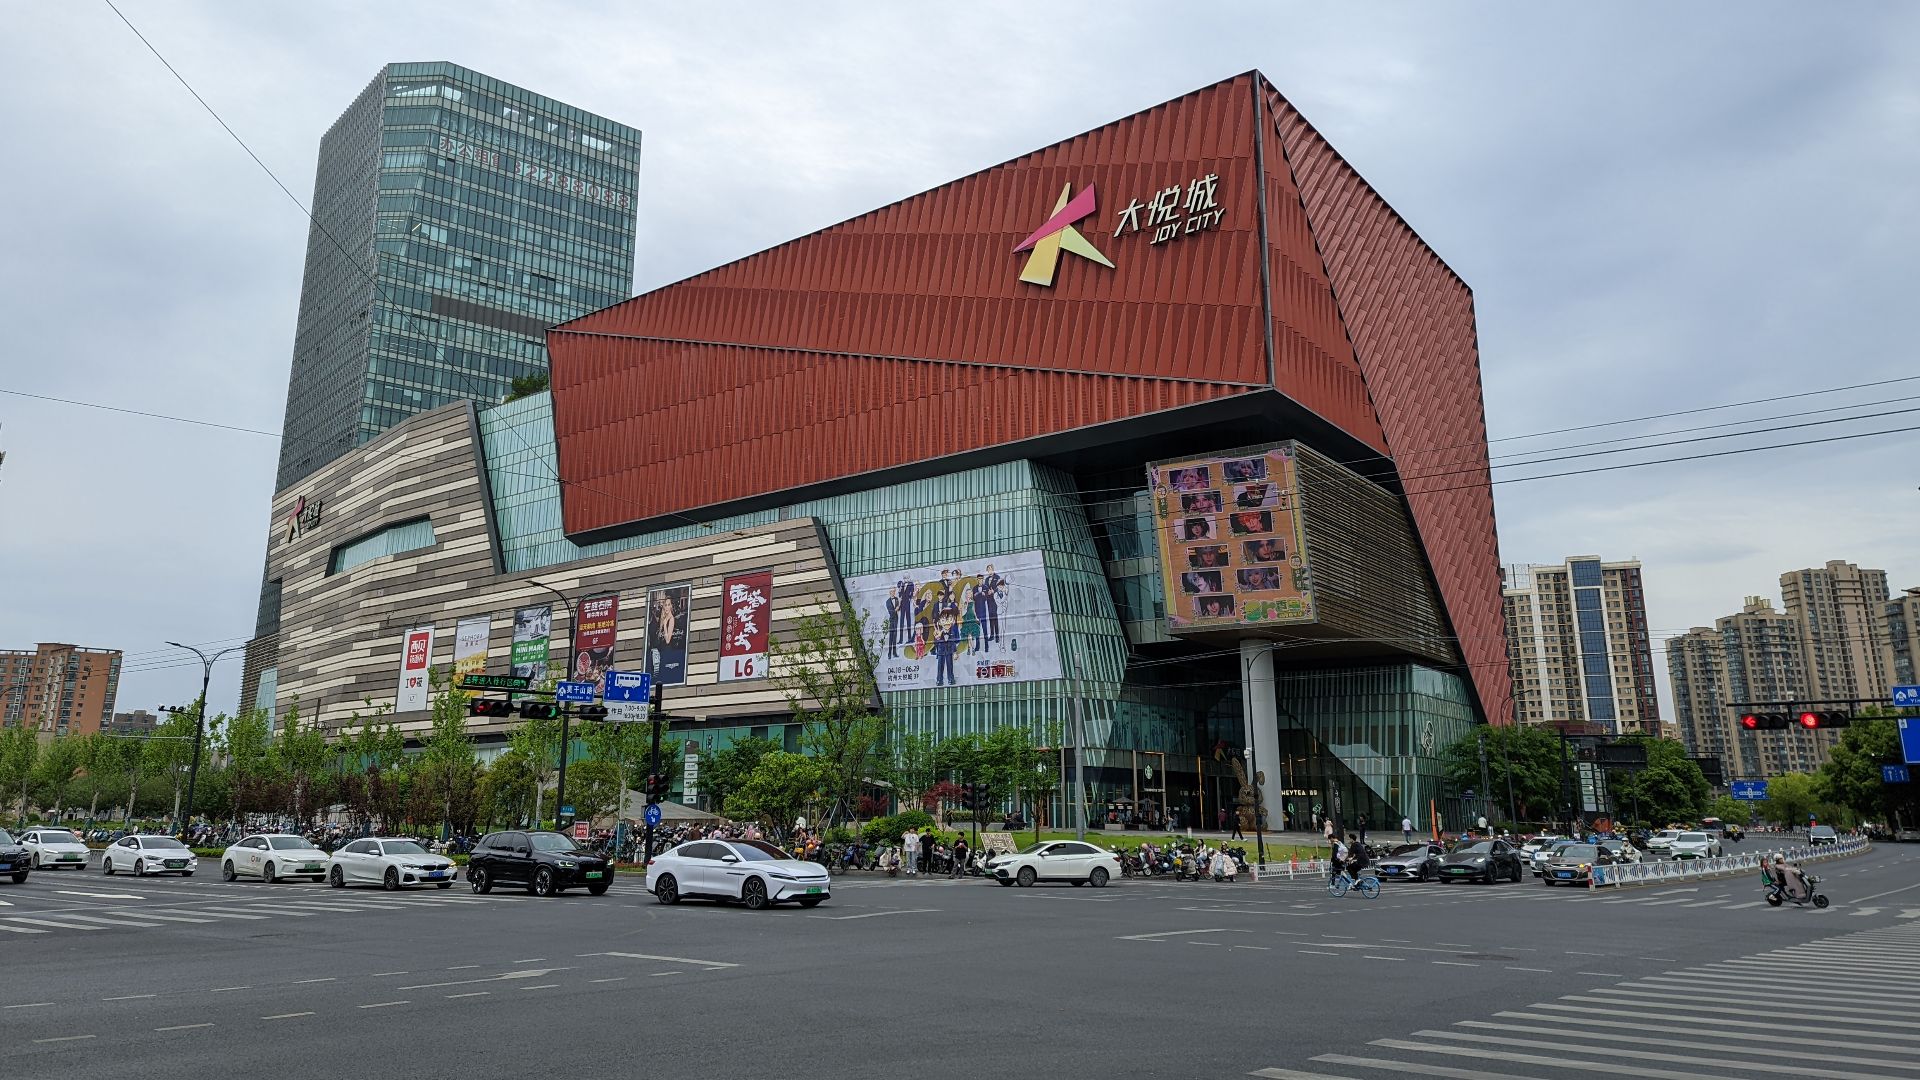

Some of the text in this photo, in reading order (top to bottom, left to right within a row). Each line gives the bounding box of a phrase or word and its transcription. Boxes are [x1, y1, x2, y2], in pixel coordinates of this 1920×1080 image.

[1113, 173, 1219, 237] 大悦城
[1150, 207, 1226, 245] JOY CITY
[515, 646, 528, 654] MINI
[528, 644, 545, 652] MARS
[734, 657, 754, 678] L6
[566, 685, 593, 695] 莫干山路
[611, 707, 623, 715] 作日
